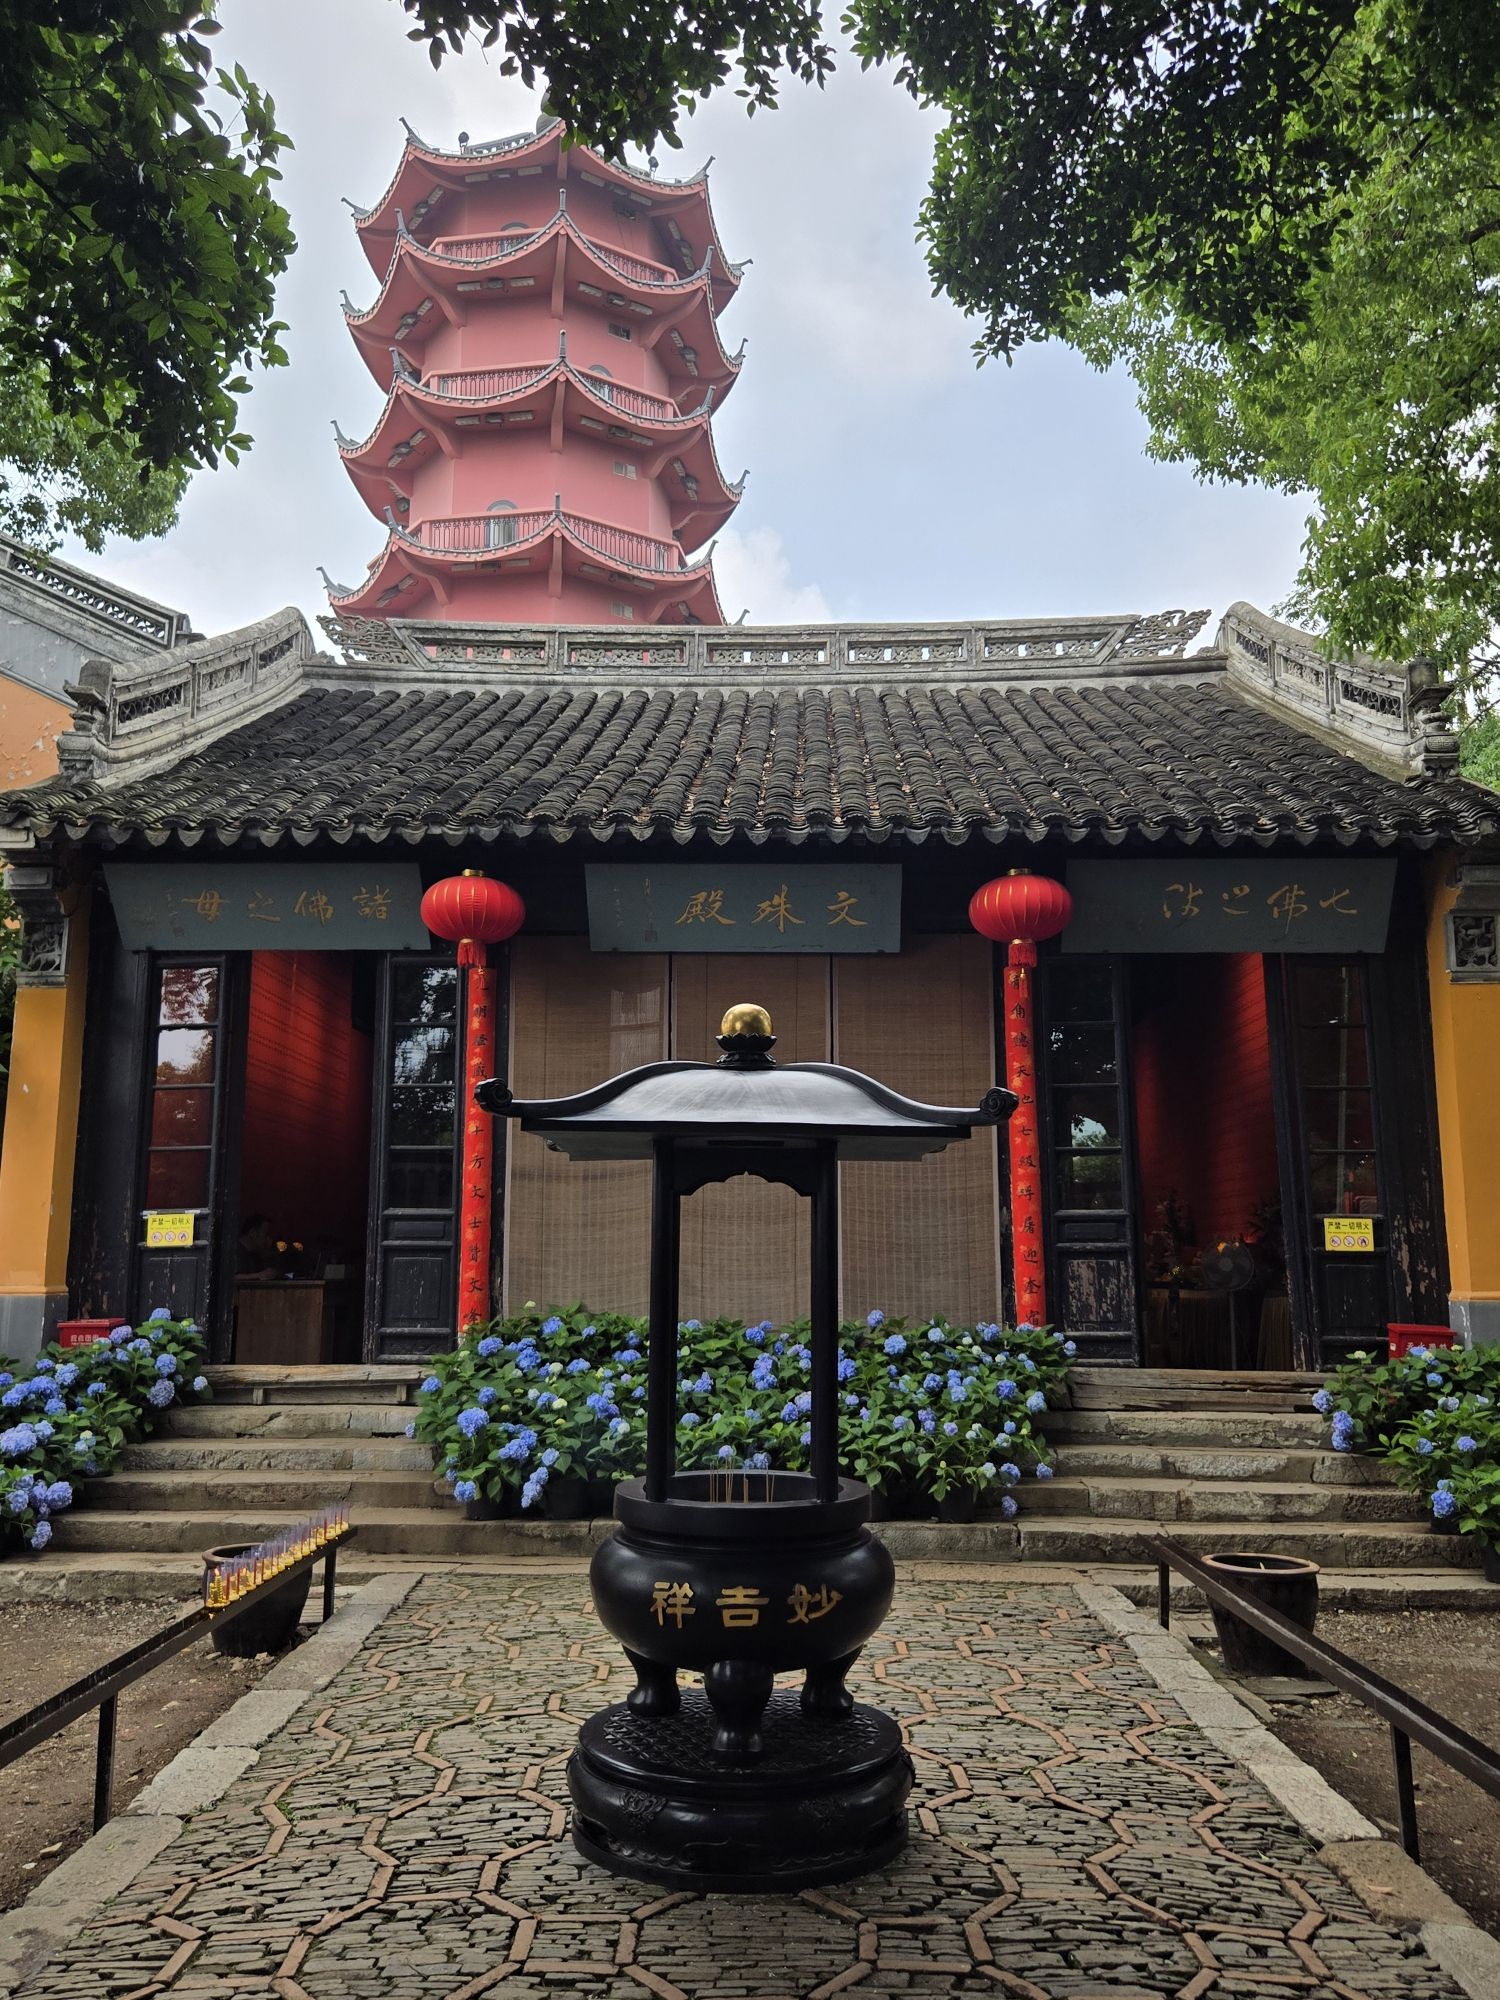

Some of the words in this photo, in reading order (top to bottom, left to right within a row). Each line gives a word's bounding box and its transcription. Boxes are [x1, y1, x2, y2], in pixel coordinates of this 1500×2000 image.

[675, 884, 868, 933] 文殊殿
[1328, 1221, 1369, 1230] 严禁一切明火
[650, 1581, 843, 1629] 妙吉祥
